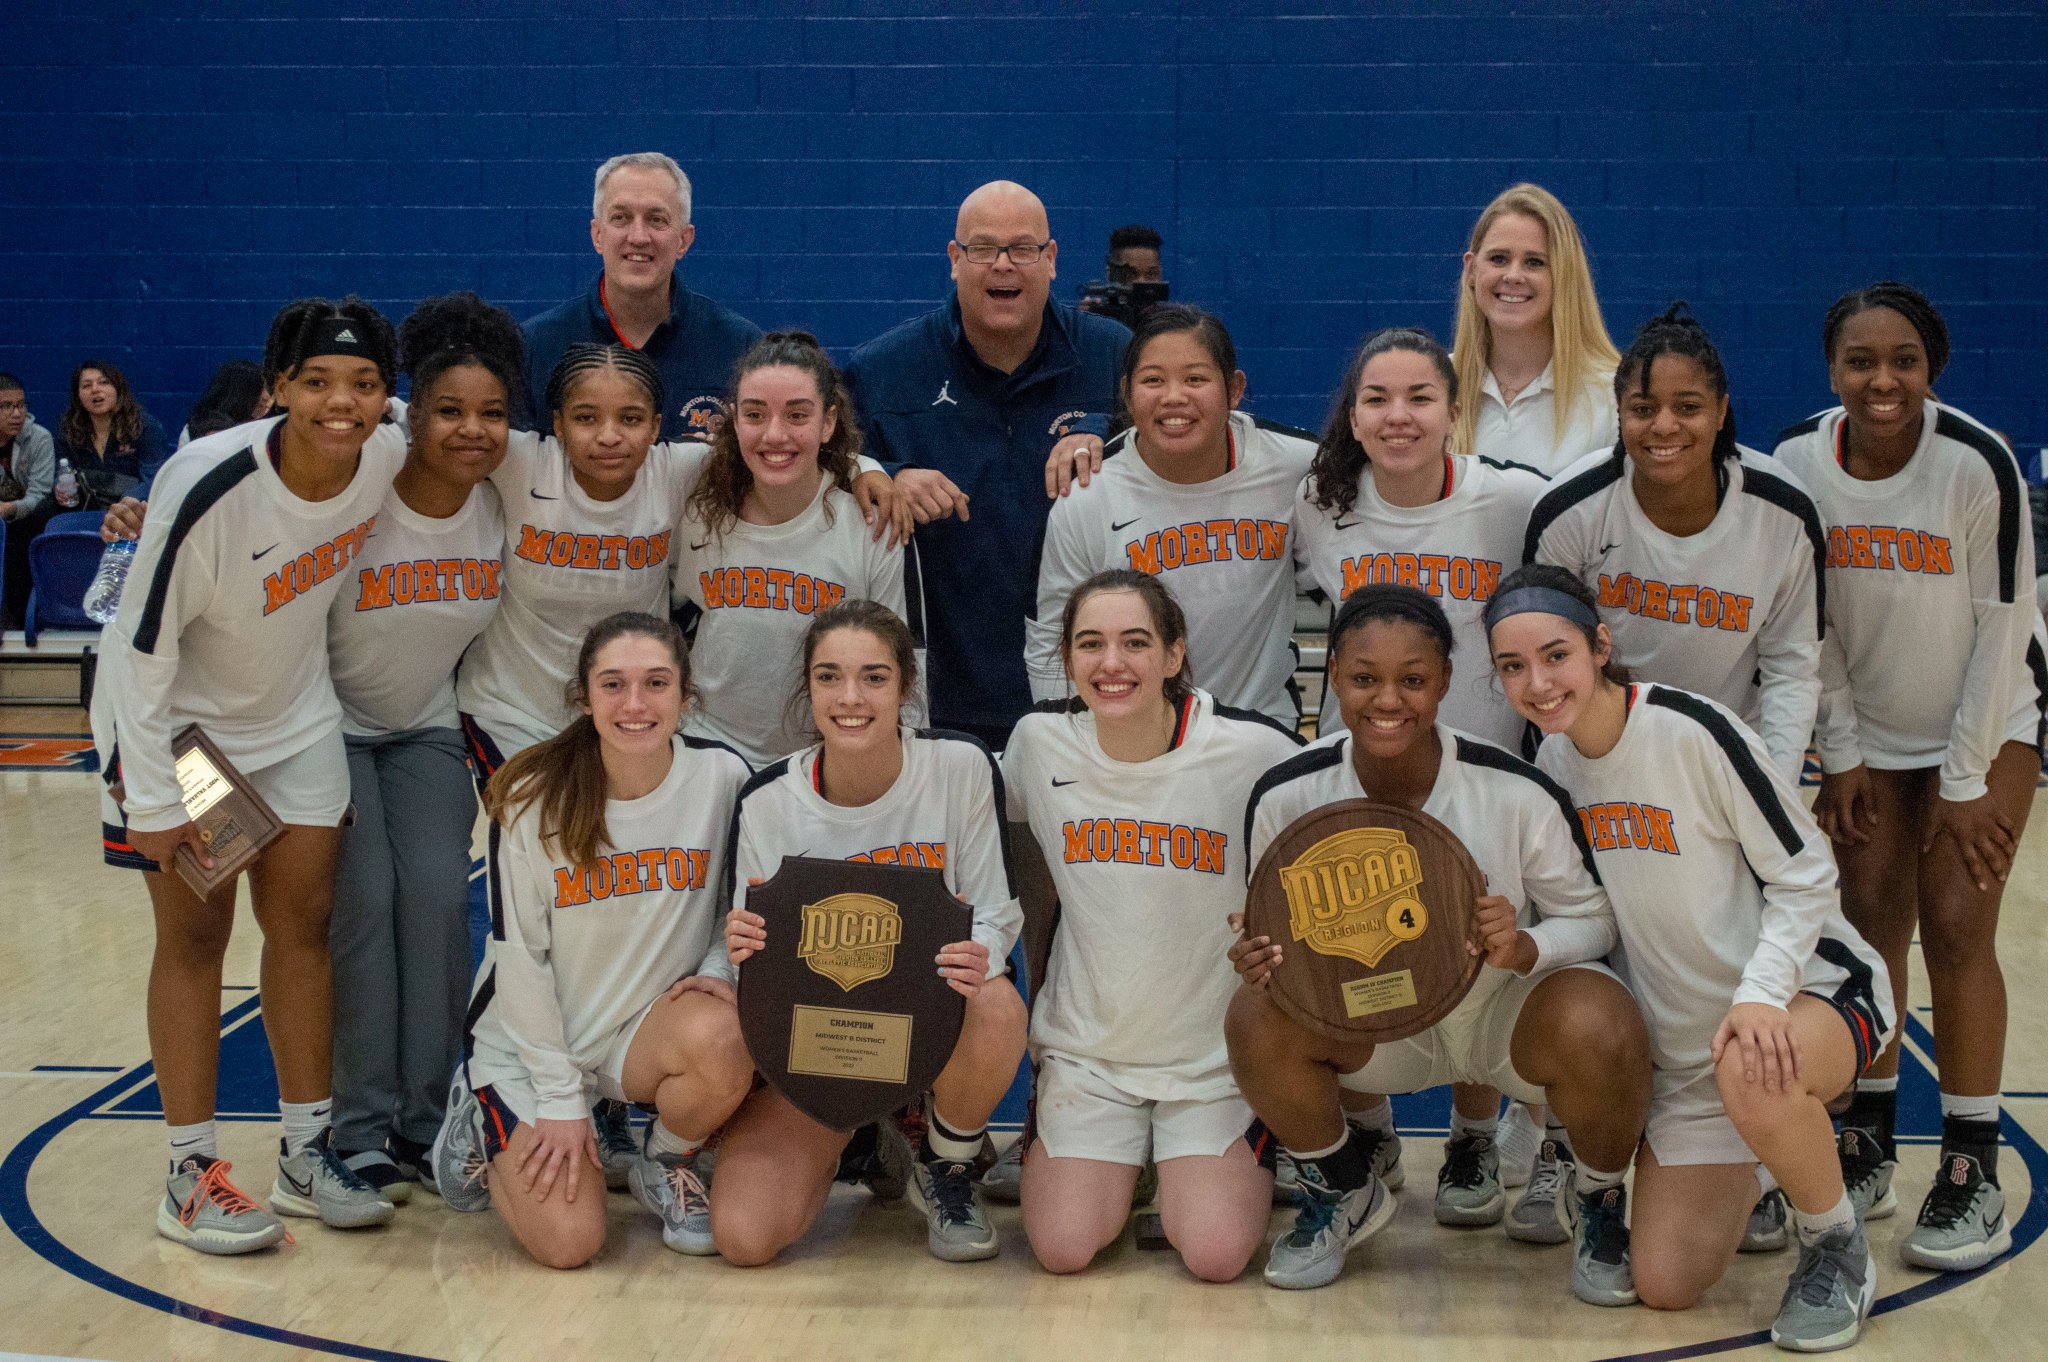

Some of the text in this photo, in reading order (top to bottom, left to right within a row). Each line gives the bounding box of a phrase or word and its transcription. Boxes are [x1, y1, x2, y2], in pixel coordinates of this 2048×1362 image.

[680, 395, 705, 417] MORTON
[1048, 411, 1073, 435] MORTON
[515, 524, 672, 570] MORTON
[1125, 519, 1289, 577] MORTON
[1825, 525, 1955, 575] ORTON
[355, 558, 501, 612] MORTON
[699, 566, 846, 618] MORTON
[1340, 552, 1502, 602] MORTON
[1596, 572, 1754, 633] MORTON
[1063, 818, 1227, 875] MORTON
[1578, 802, 1680, 855] ORTON
[554, 847, 710, 908] MORTON
[1286, 848, 1417, 934] NJCAA
[802, 909, 899, 953] NJCAA
[1323, 908, 1415, 941] REGION 4
[815, 1032, 847, 1041] MIDWEST
[856, 1036, 886, 1044] DISTRICT
[830, 1019, 874, 1030] CHAMPION
